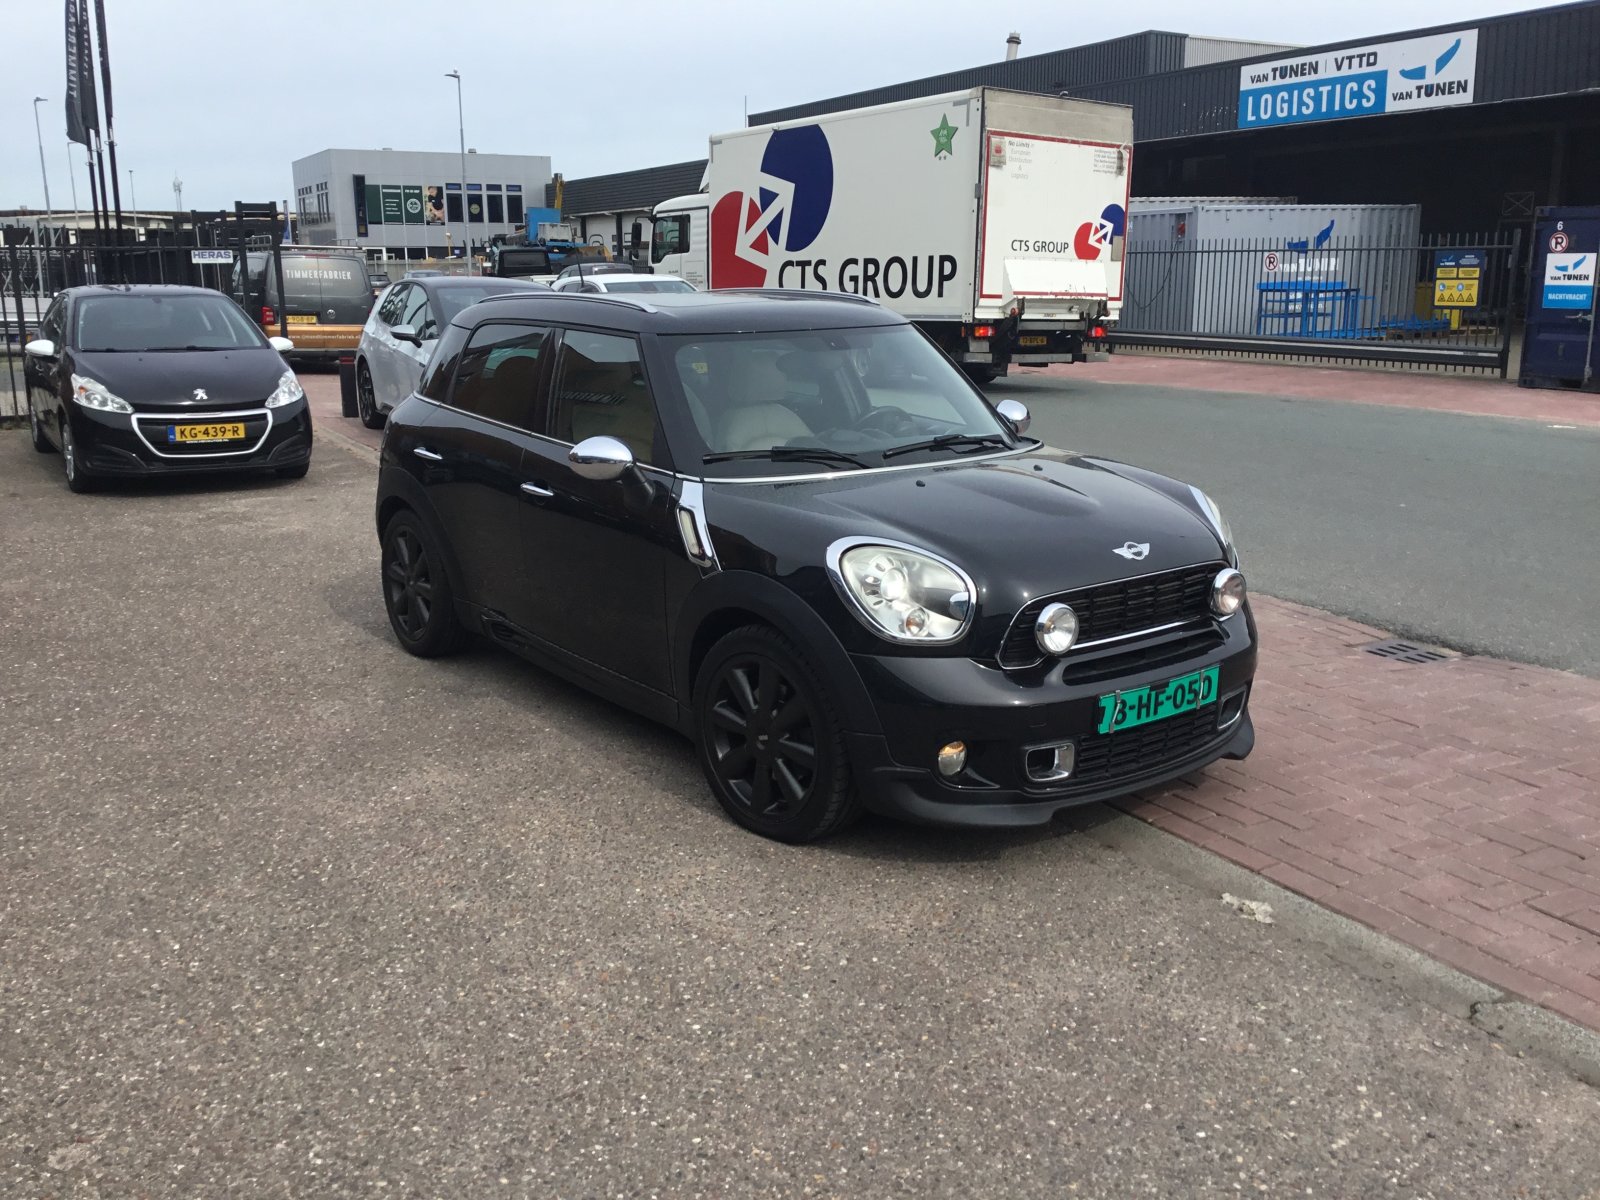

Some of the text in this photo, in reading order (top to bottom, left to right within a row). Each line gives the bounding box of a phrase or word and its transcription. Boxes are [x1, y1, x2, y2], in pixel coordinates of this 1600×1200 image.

[1334, 51, 1378, 72] VTTD
[1250, 60, 1319, 84] VAN TUNEN
[1392, 79, 1468, 102] VAN TUNEN
[1247, 79, 1377, 121] LOGISTICS
[1557, 221, 1563, 231] 6
[1011, 239, 1069, 254] CTS GROUP
[193, 251, 232, 259] HERAS
[286, 269, 352, 280] TIMMERFABRIEK
[778, 254, 958, 299] CTS GROUP
[1562, 273, 1590, 281] TUNEN
[180, 425, 241, 439] KG-439-R
